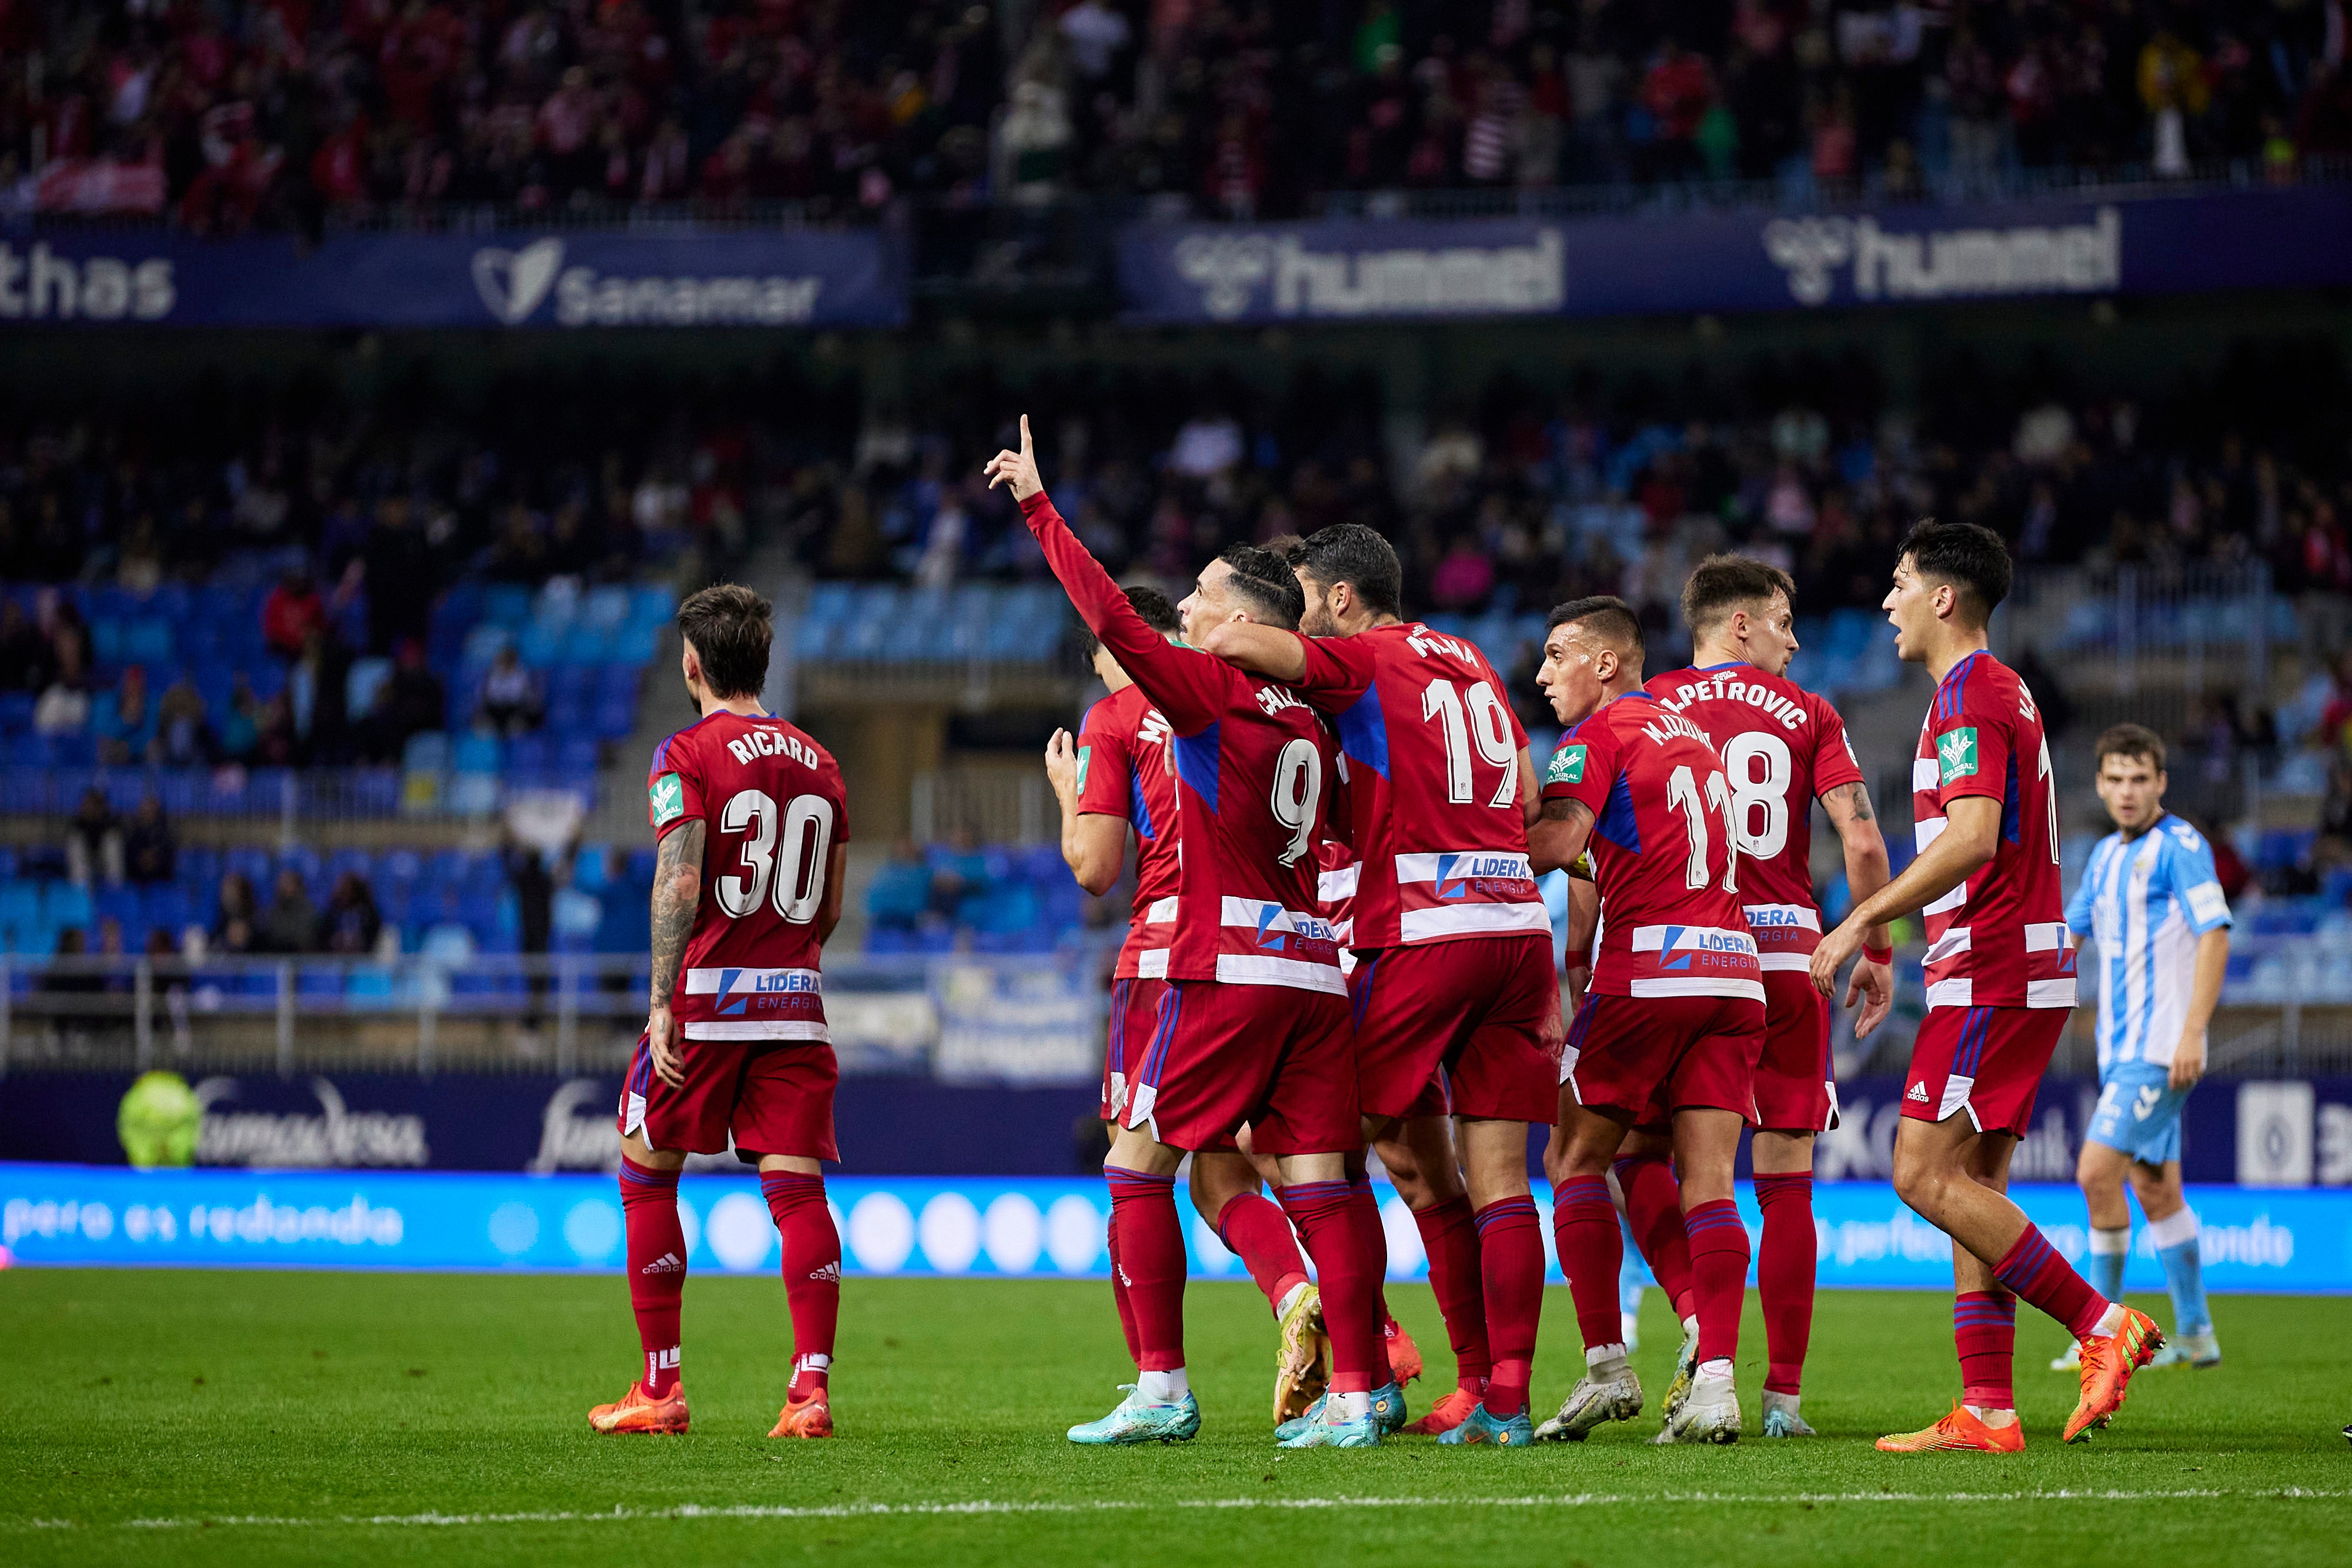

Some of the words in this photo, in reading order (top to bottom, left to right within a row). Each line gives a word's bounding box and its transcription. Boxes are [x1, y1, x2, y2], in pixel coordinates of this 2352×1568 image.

[555, 266, 821, 326] Sanamar
[727, 731, 818, 771] RICARD
[1421, 678, 1519, 809] 19
[1271, 738, 1322, 869] 9
[1703, 731, 1792, 861] 8
[1666, 765, 1739, 894] 11
[714, 789, 834, 925] 30
[1472, 858, 1527, 878] LIDERA
[1745, 909, 1799, 926] DERA
[1699, 933, 1754, 955] LIDERA
[755, 974, 819, 994] LIDERA
[1907, 1092, 1929, 1103] adidas
[810, 1270, 840, 1284] adida
